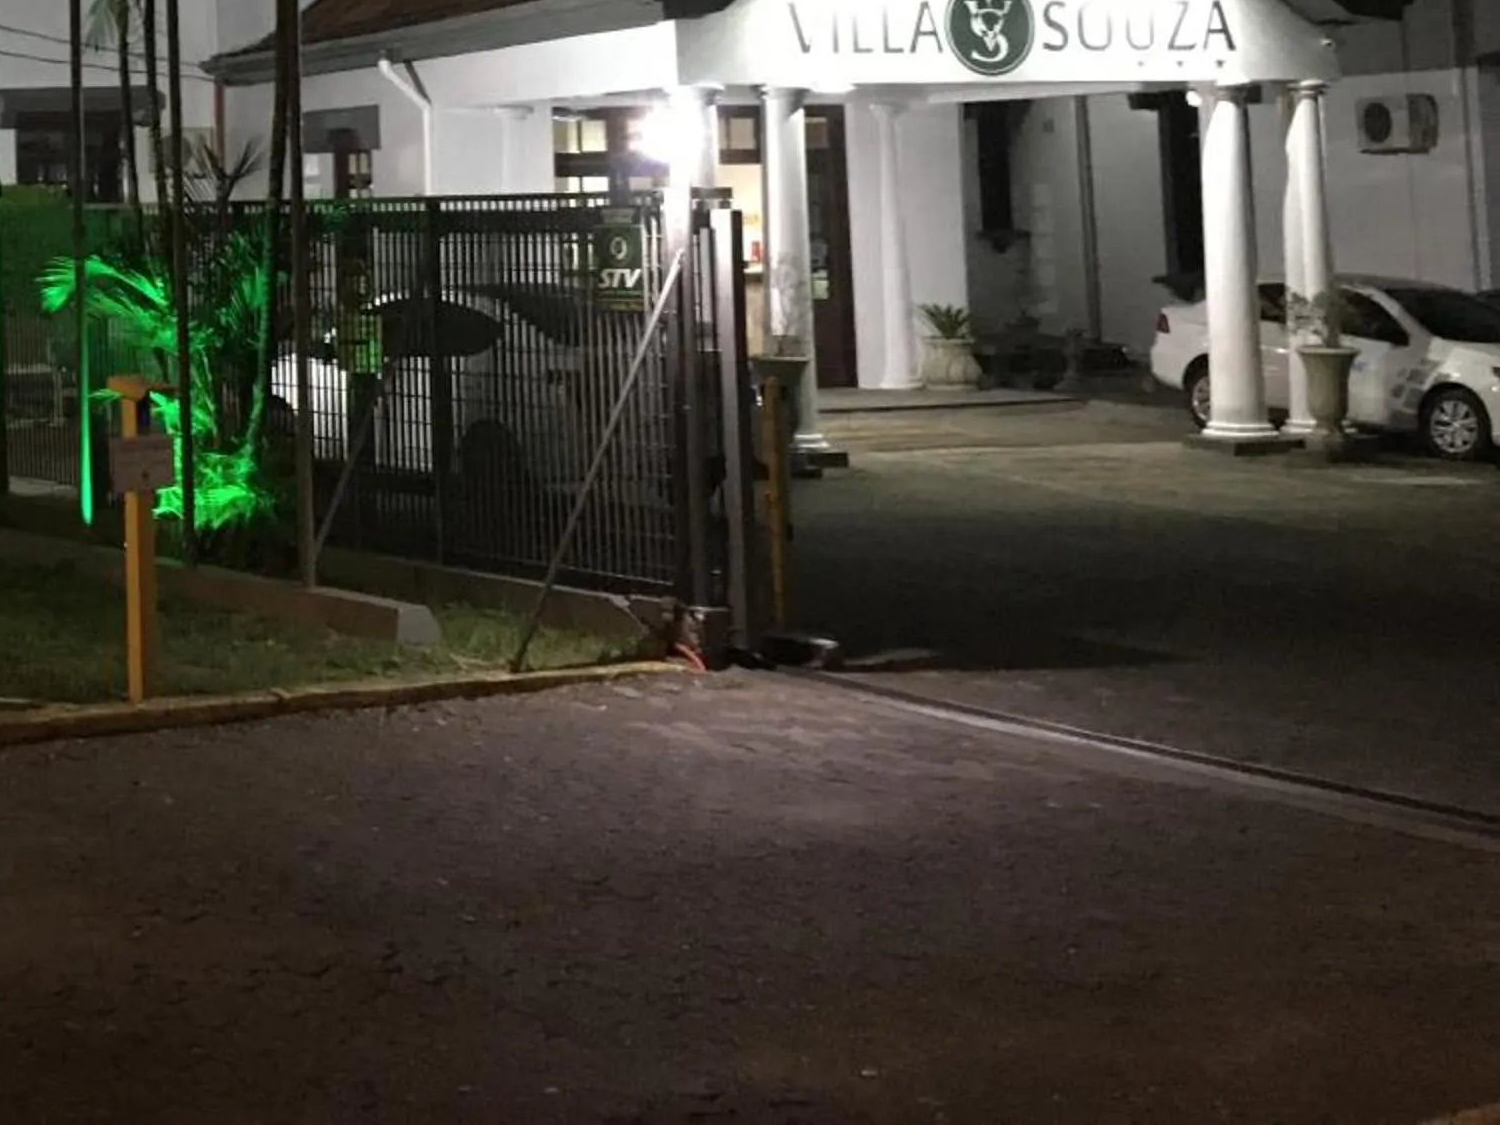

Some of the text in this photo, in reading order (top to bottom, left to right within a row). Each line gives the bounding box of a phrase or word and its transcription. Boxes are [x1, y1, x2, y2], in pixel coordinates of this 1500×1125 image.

[788, 0, 1238, 54] VILLA SOUZA
[598, 267, 642, 288] STV
